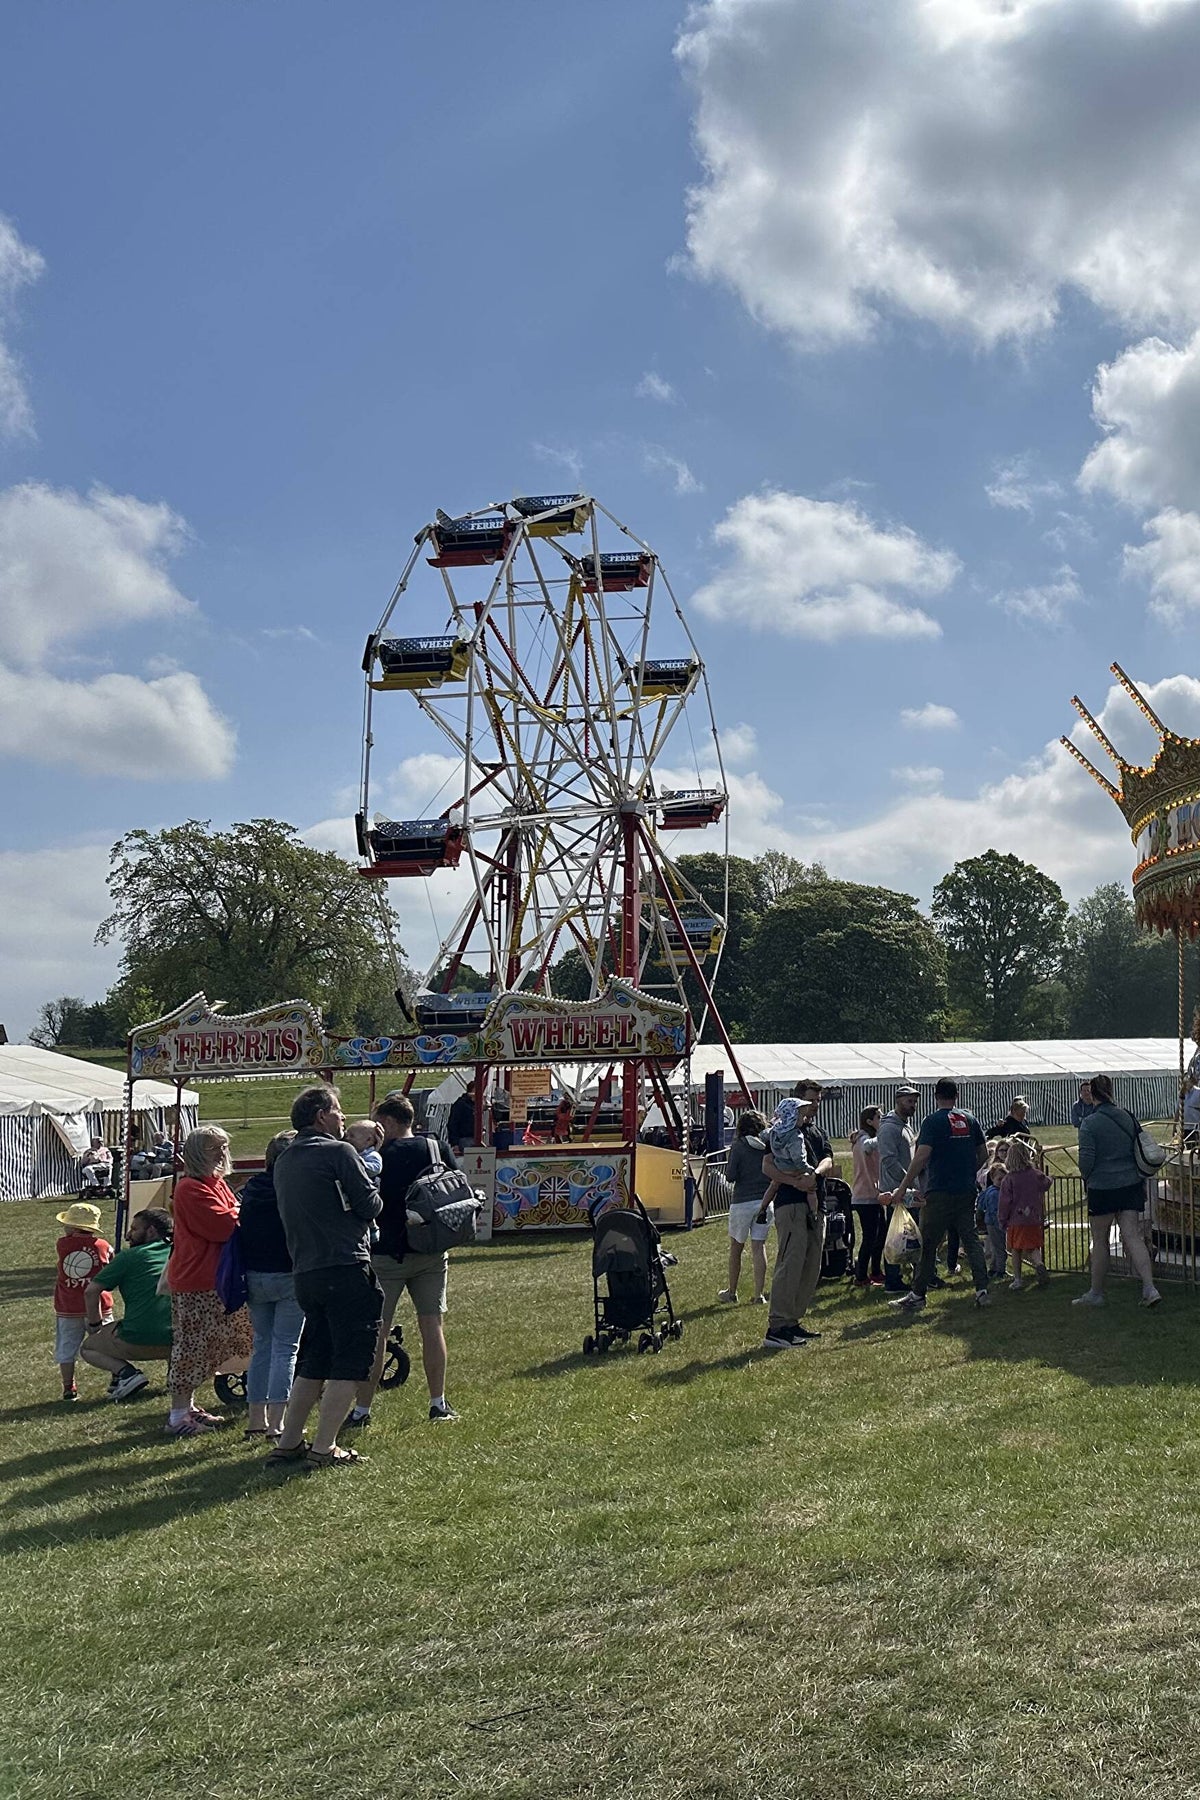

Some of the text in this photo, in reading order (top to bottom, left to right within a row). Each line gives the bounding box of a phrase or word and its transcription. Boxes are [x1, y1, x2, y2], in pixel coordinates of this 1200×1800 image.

[542, 497, 576, 506] WHEEL
[470, 520, 504, 531] FERRIS
[608, 554, 640, 563] FERRIS
[175, 1013, 641, 1069] FERRIS WHEEL
